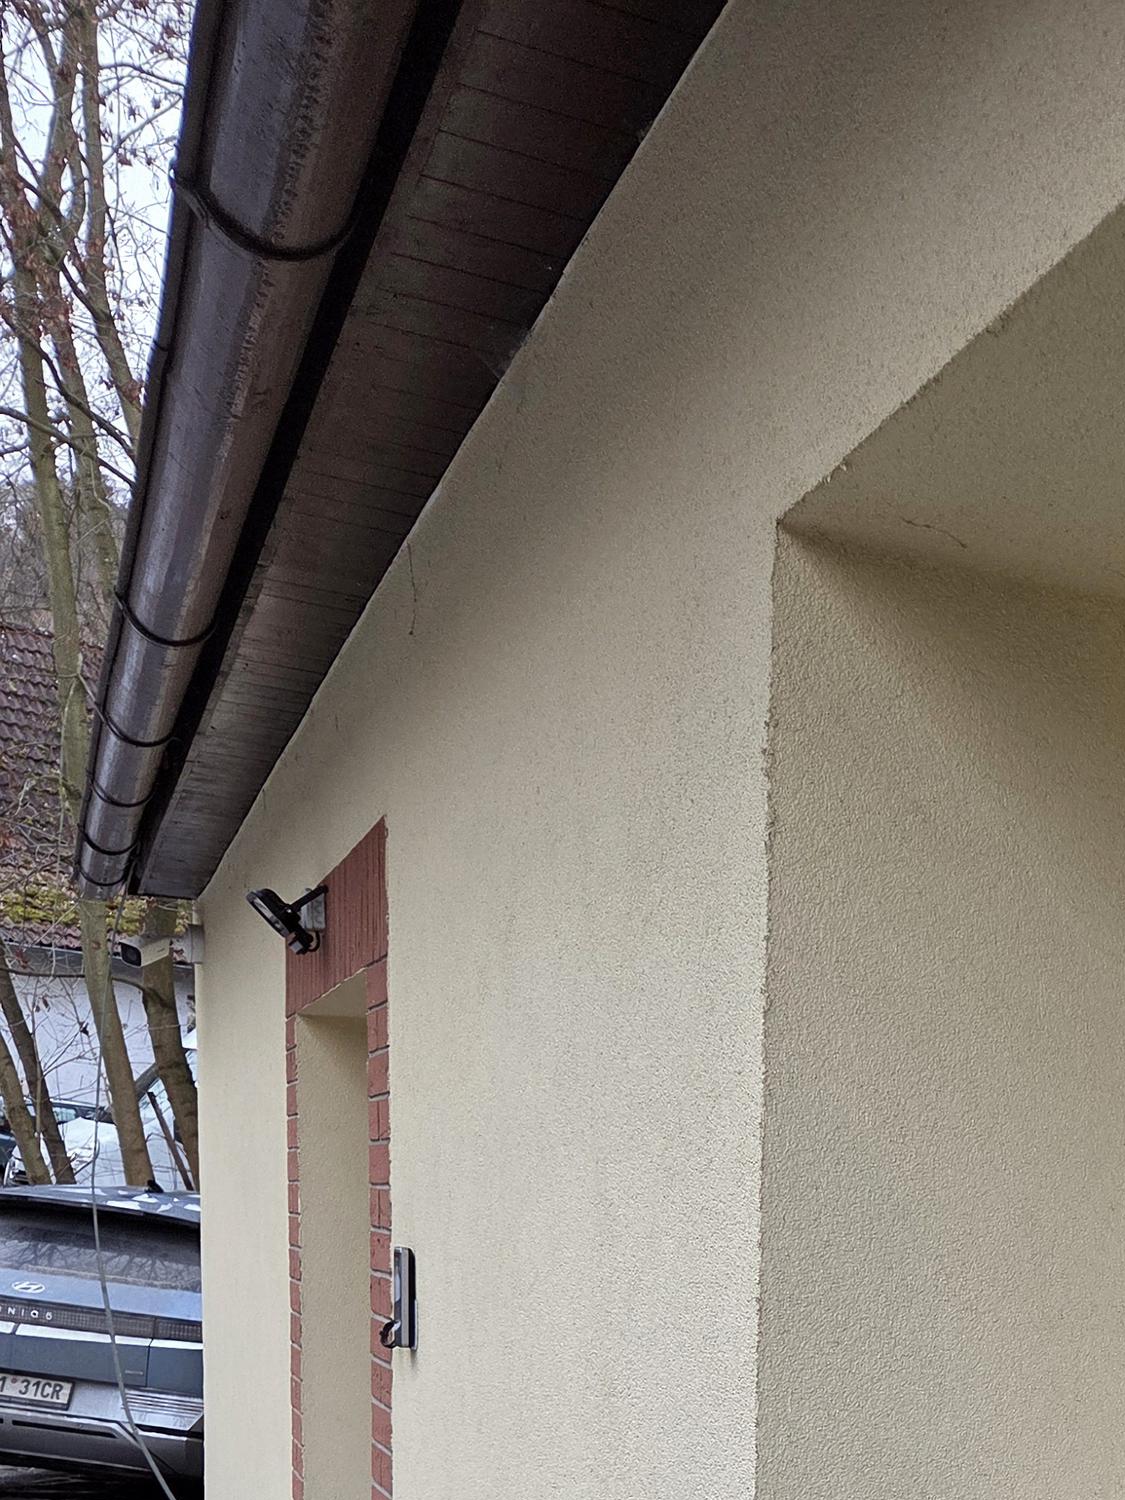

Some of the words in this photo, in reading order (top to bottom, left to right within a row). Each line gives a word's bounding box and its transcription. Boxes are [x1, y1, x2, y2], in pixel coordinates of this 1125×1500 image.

[0, 1305, 39, 1318] NIQ
[45, 1311, 53, 1320] 6
[19, 1379, 63, 1400] 31CR
